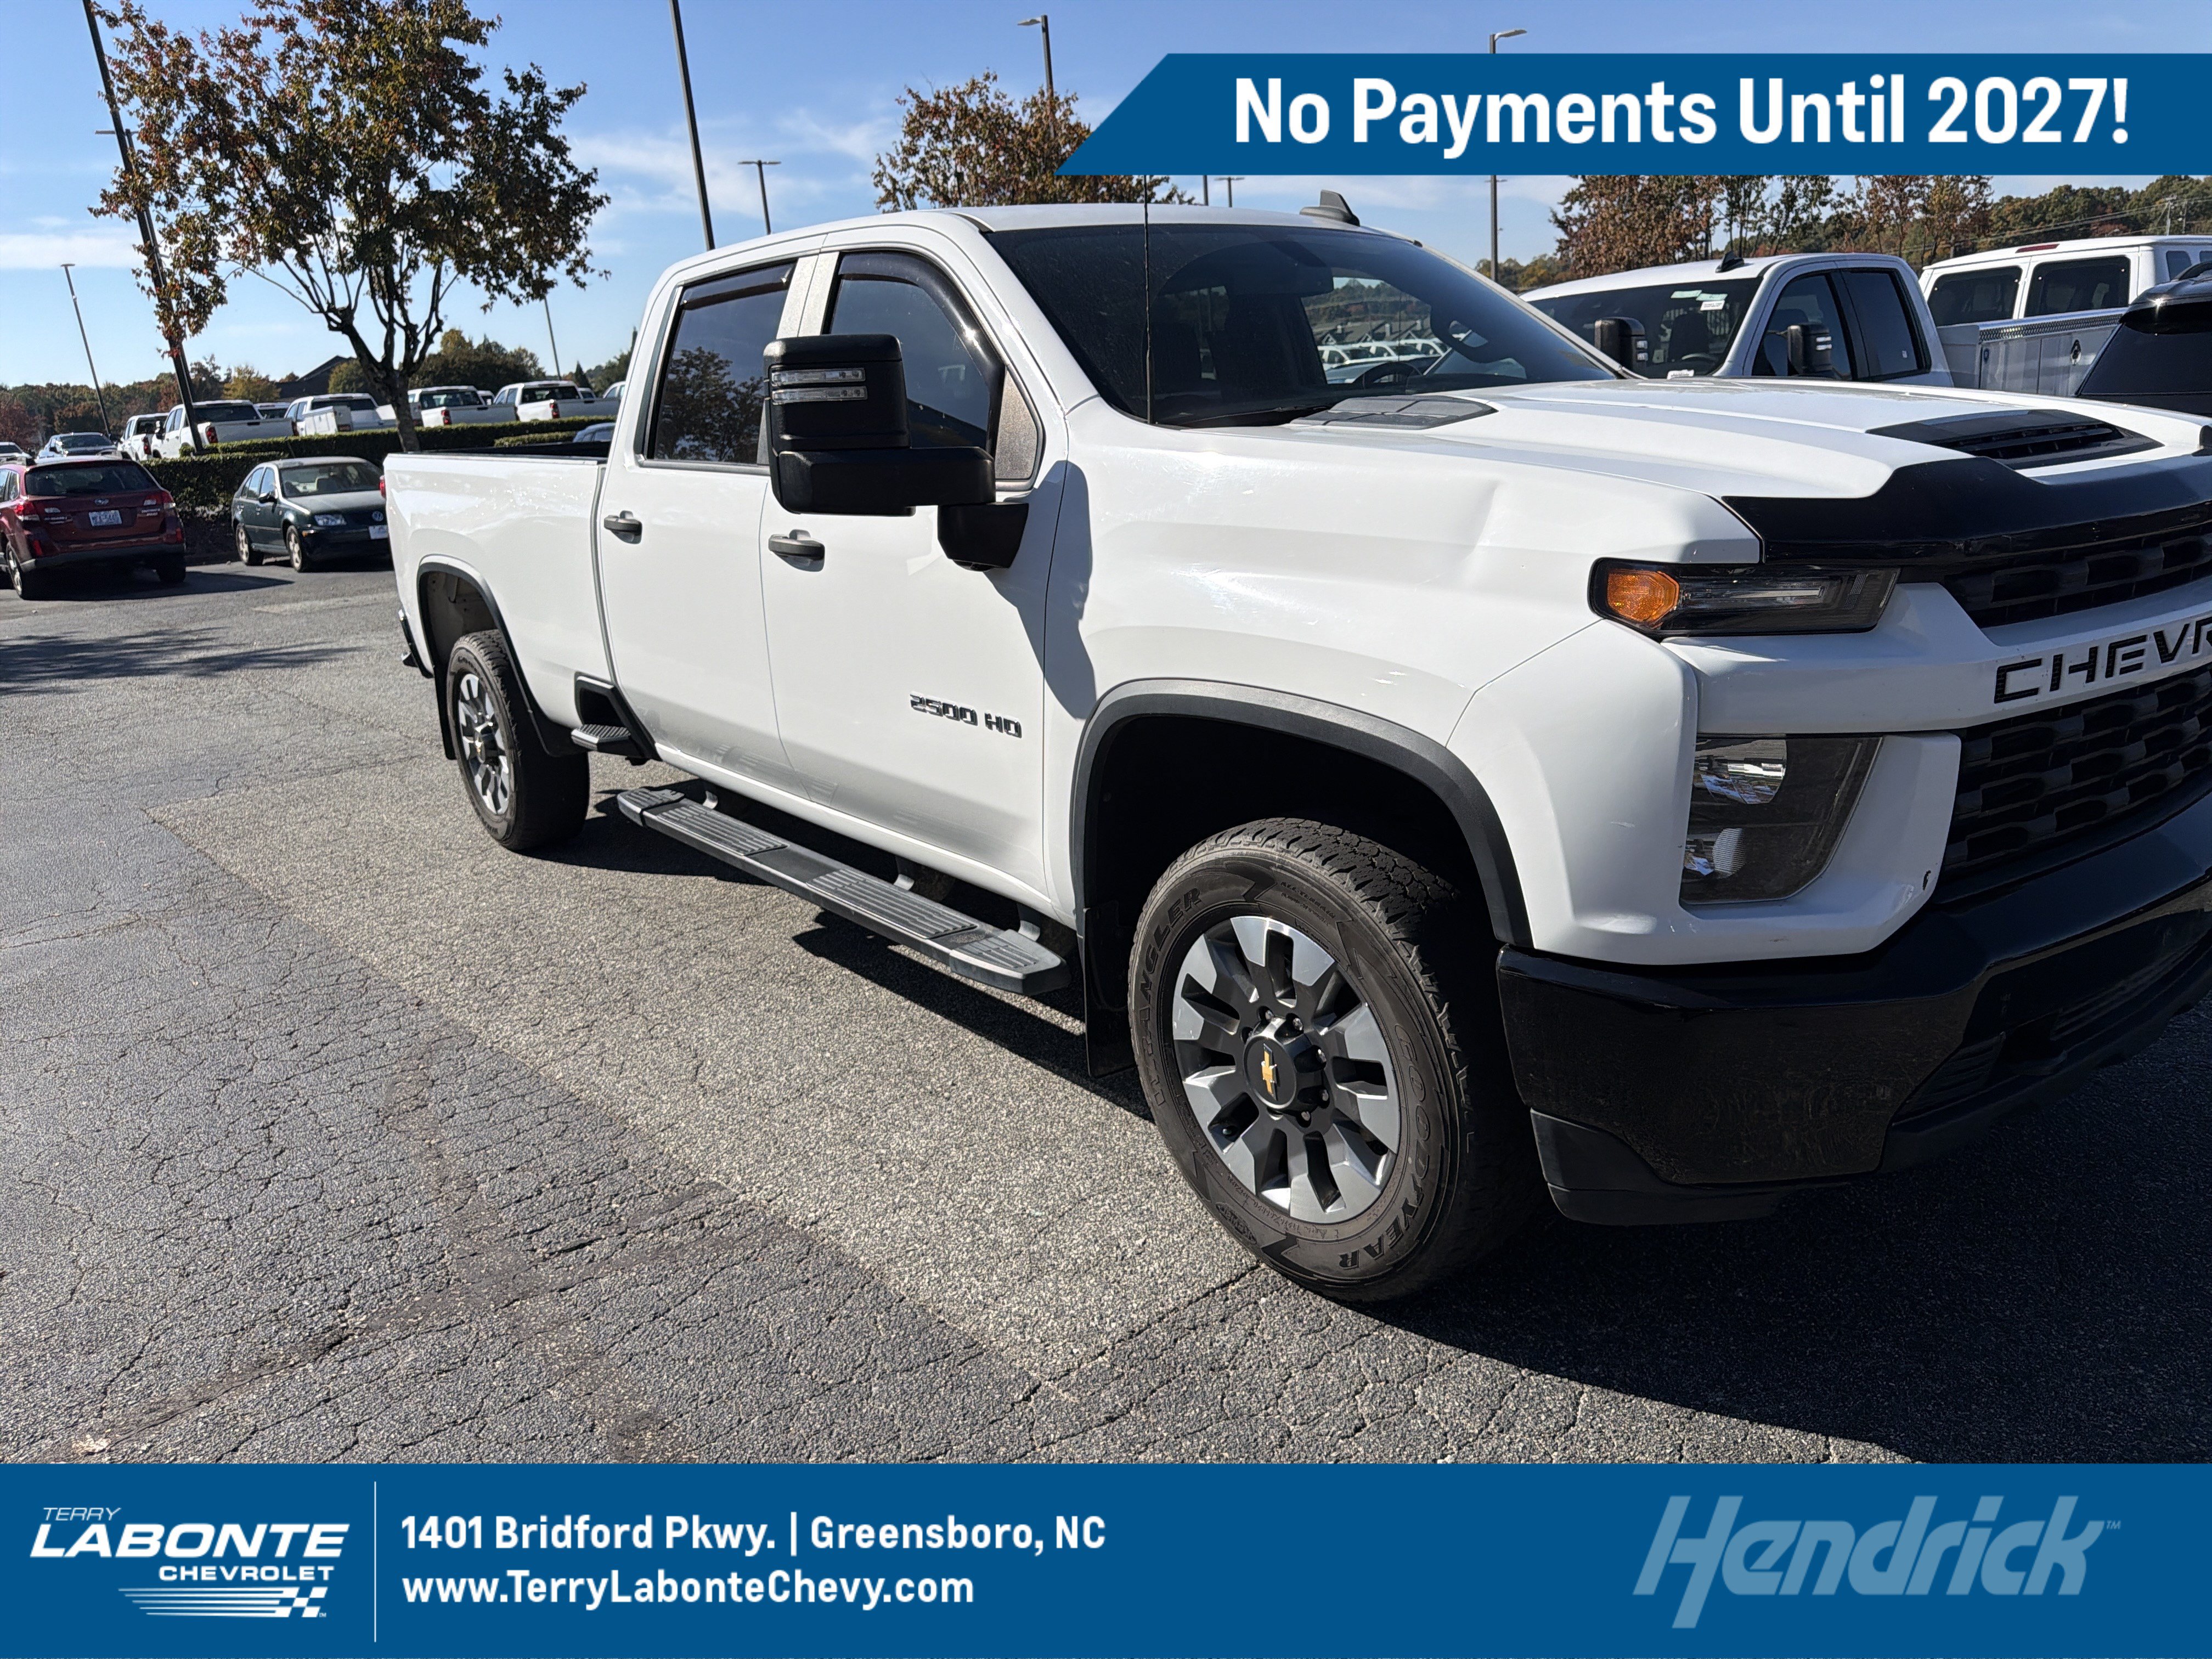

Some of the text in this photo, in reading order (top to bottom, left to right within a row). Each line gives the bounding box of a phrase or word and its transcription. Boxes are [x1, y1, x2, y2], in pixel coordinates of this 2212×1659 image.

[909, 692, 1022, 738] 2500 HD
[1339, 1024, 1431, 1270] GOODYEAR
